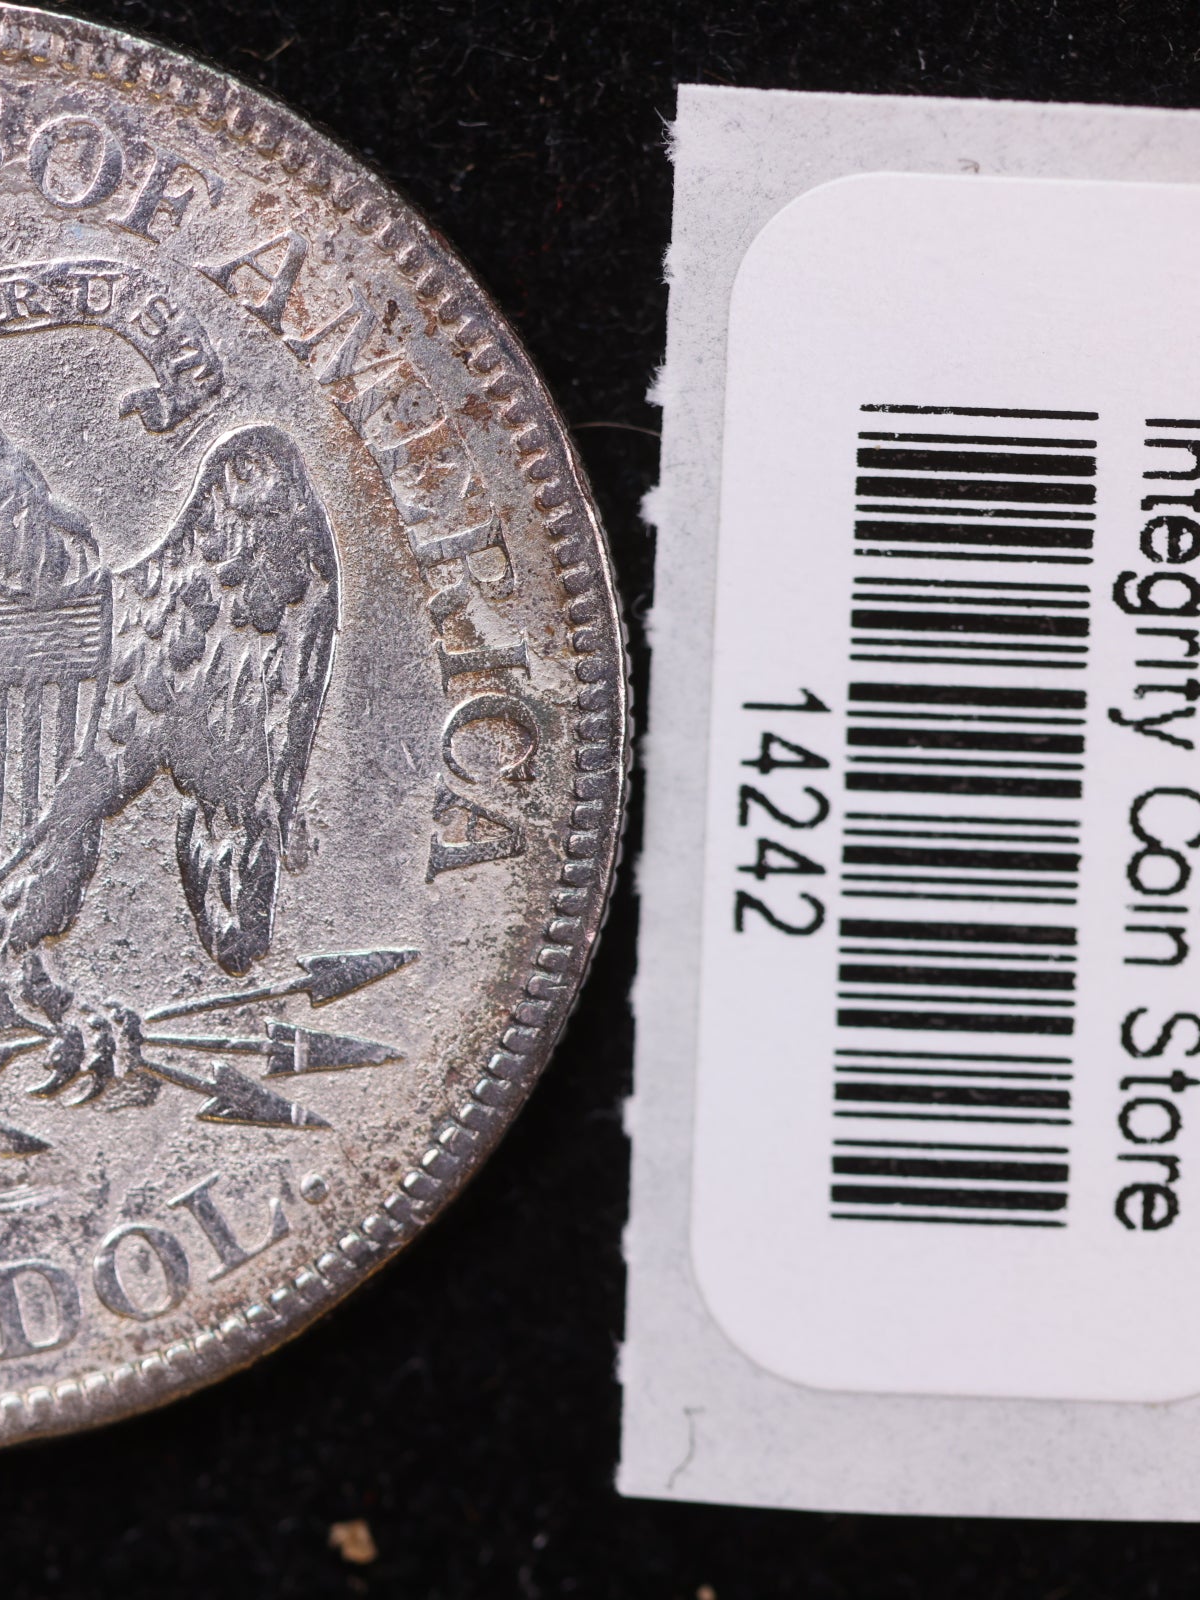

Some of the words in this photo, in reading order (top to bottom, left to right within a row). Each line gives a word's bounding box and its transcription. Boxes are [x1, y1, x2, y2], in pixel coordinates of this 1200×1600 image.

[28, 115, 224, 243] OF
[196, 230, 539, 884] AMERICA
[1108, 418, 1200, 750] Integrity
[734, 688, 831, 934] 14242
[1123, 787, 1200, 966] Coin
[1115, 1007, 1200, 1231] Store
